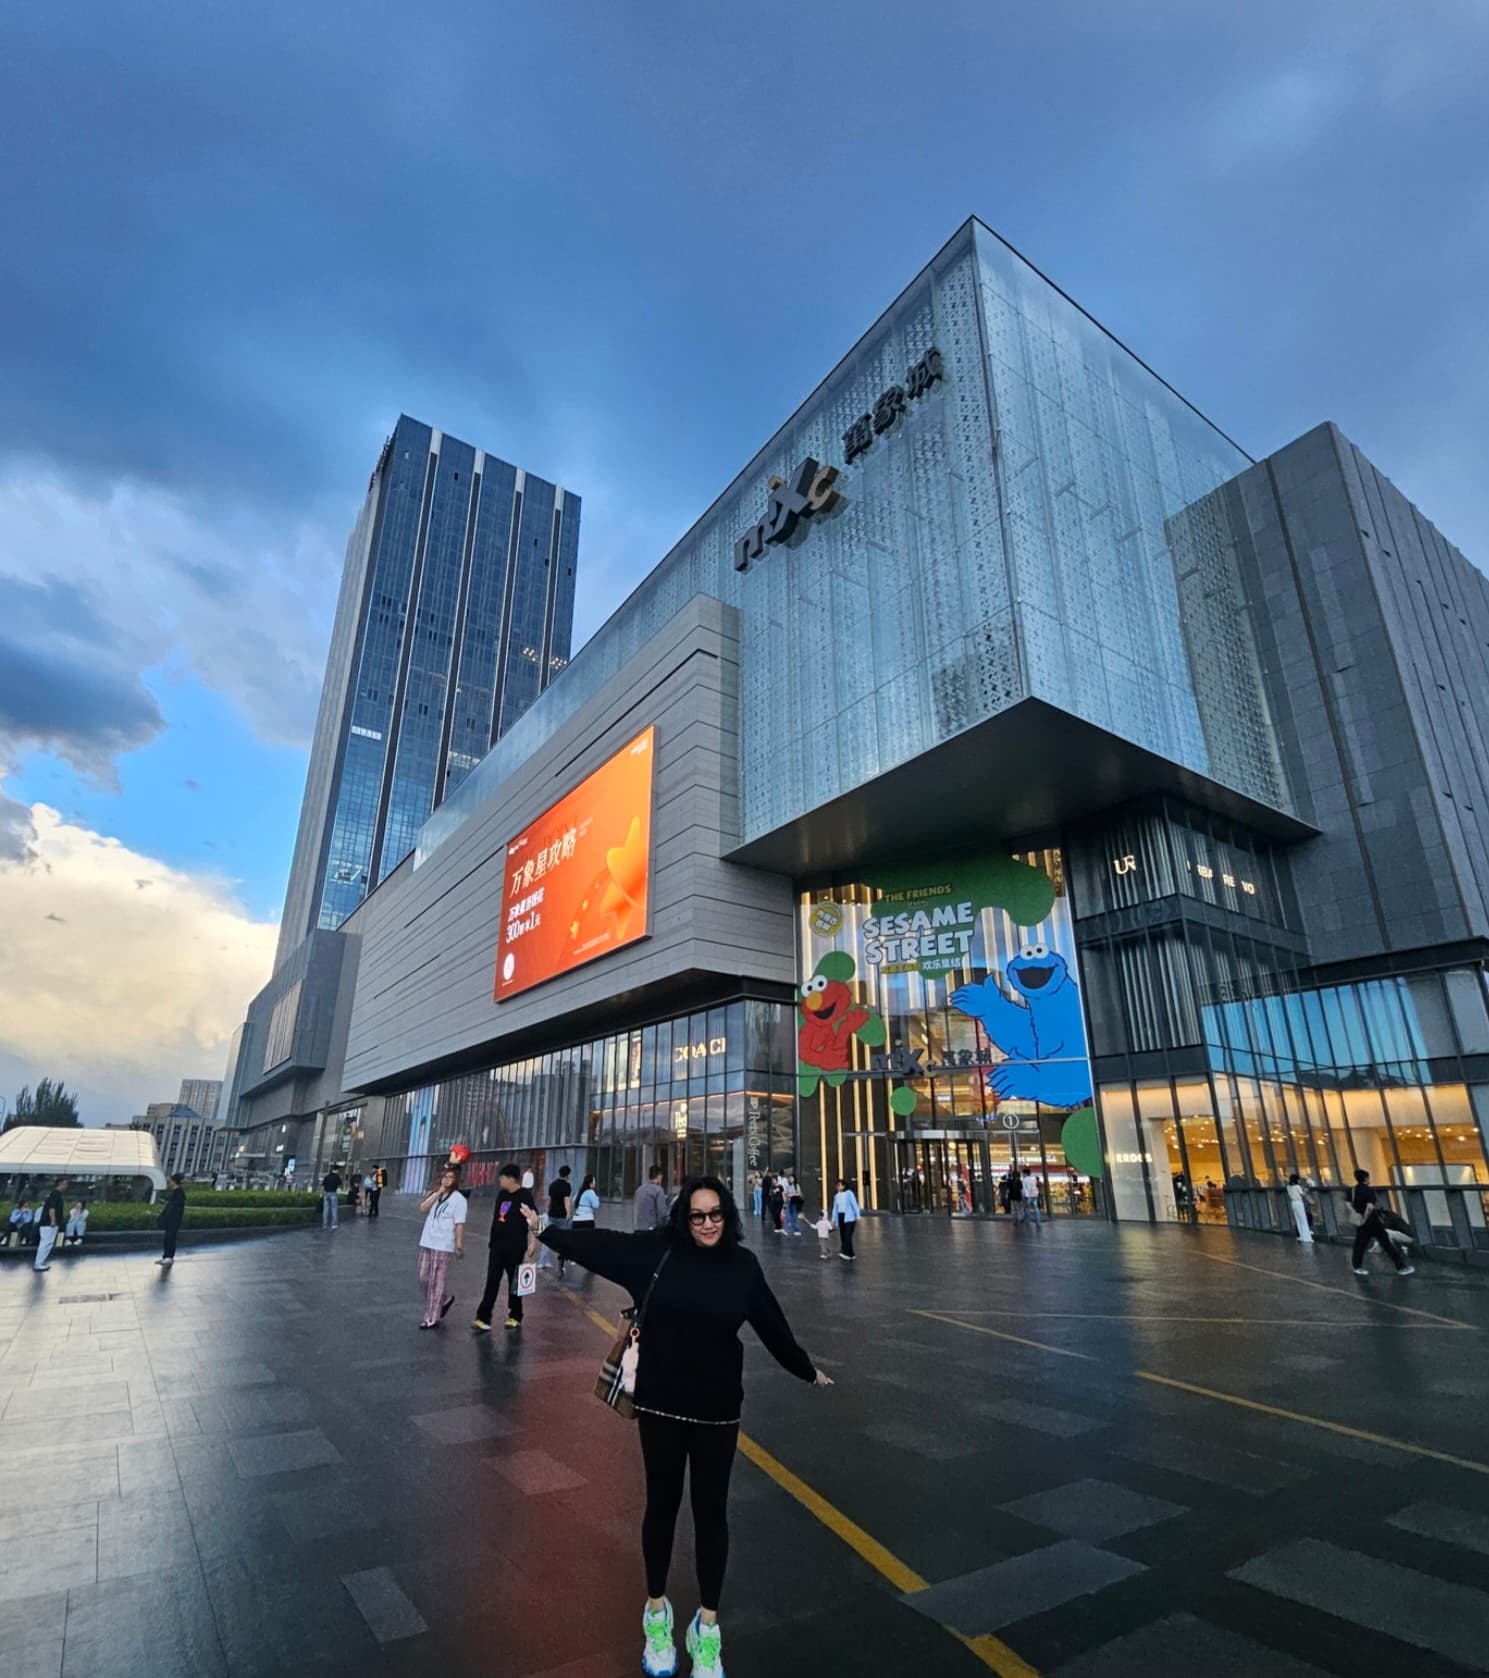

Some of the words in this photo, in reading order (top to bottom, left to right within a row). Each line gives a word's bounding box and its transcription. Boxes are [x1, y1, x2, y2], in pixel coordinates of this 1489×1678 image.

[509, 828, 577, 898] 万象星攻略
[1113, 855, 1137, 875] UR
[884, 893, 905, 903] THE
[906, 884, 952, 900] FRIENDS
[863, 902, 974, 939] SESAME
[865, 929, 974, 965] STREET
[747, 1136, 761, 1167] Coffee
